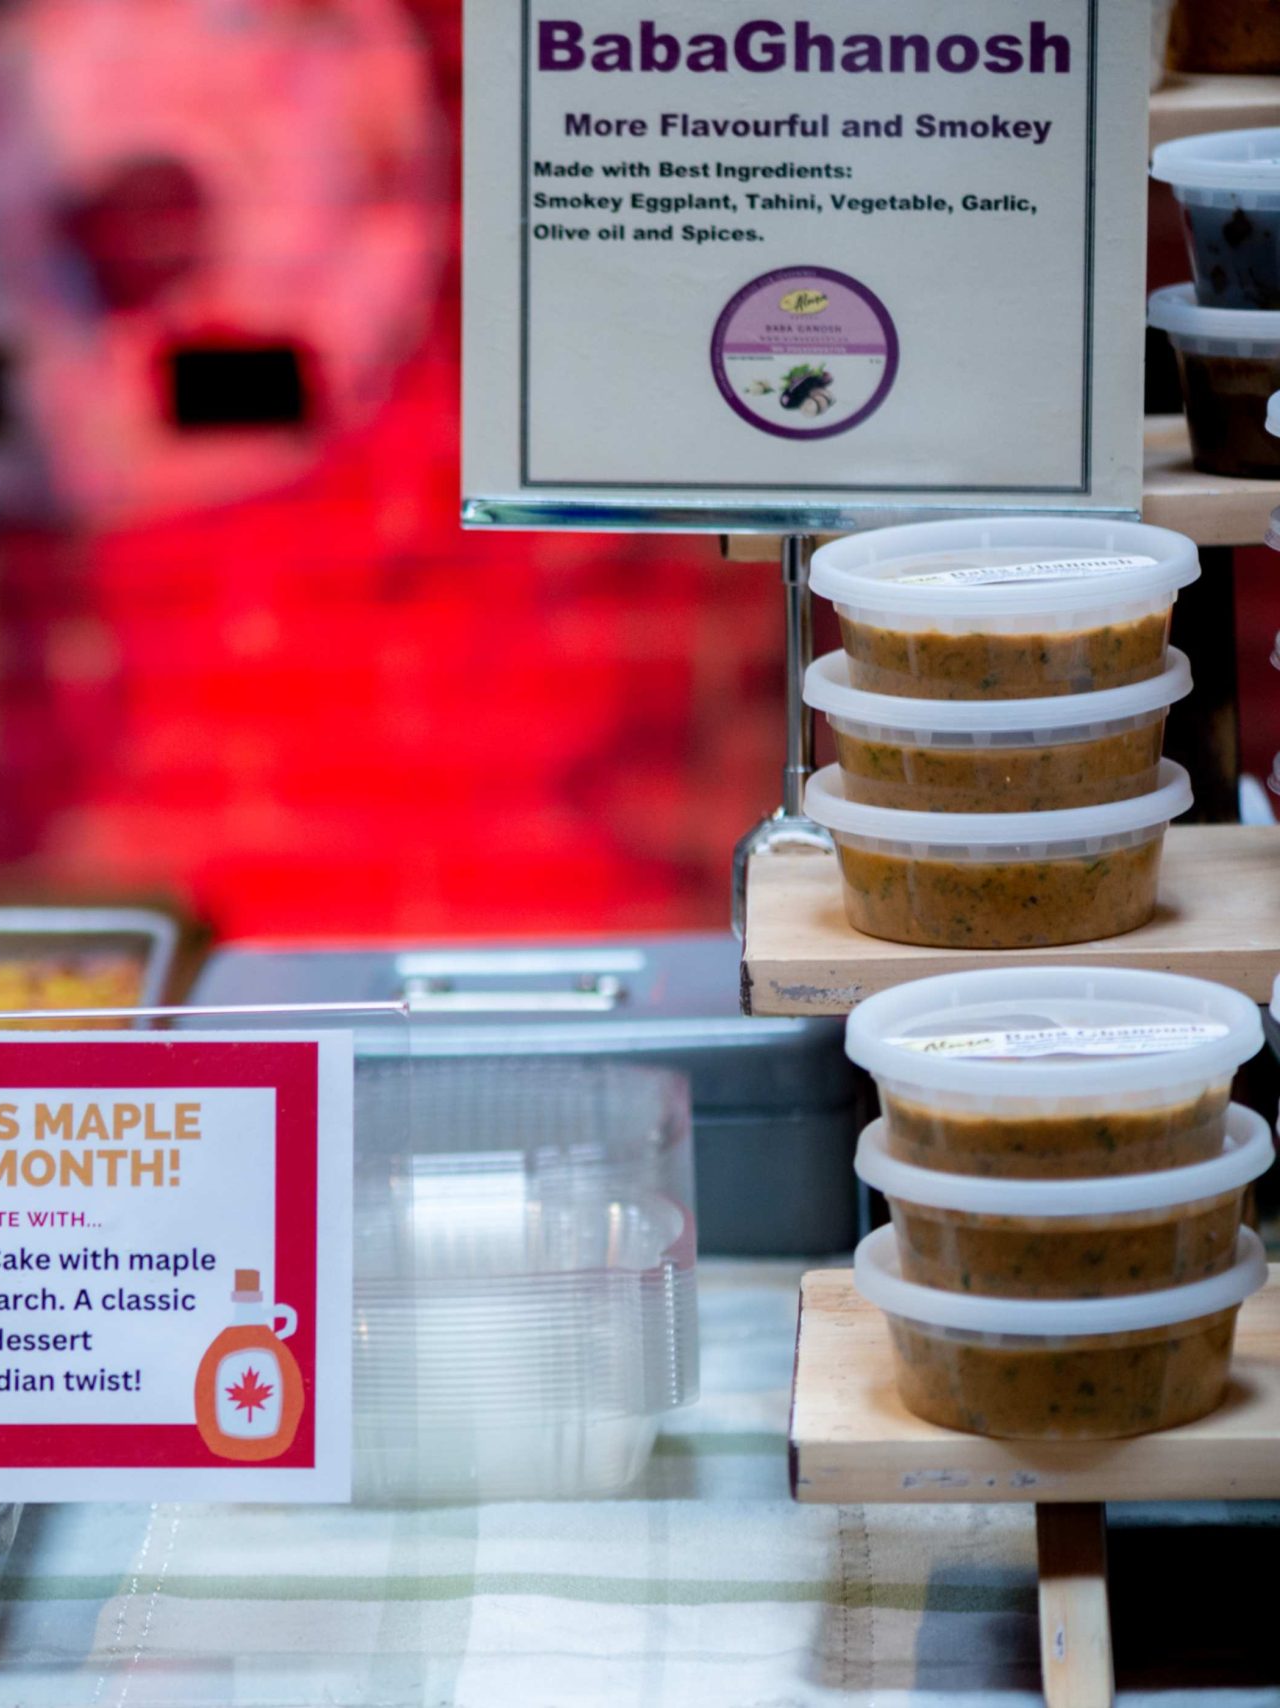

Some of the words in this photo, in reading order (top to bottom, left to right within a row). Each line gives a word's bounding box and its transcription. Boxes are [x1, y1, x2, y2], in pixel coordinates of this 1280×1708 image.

[538, 19, 1071, 75] BabaGhanosh
[565, 113, 647, 137] More
[660, 113, 829, 138] Flavourful
[841, 114, 903, 138] and
[915, 113, 1053, 145] Smokey
[533, 161, 594, 178] Made
[601, 161, 651, 178] with
[658, 161, 710, 178] Best
[716, 161, 852, 183] Ingredients:
[533, 192, 623, 213] Smokey
[630, 192, 738, 214] Eggplant,
[745, 193, 823, 213] Tahini,
[830, 194, 954, 215] Vegetable,
[961, 194, 1038, 215] Garlic,
[533, 224, 591, 241] Olive
[597, 224, 625, 241] oil
[632, 224, 674, 241] and
[681, 224, 764, 245] Spices.
[34, 1102, 202, 1141] MAPLE
[26, 1211, 102, 1228] WITH...
[58, 1247, 119, 1271] with
[128, 1247, 217, 1277] maple
[73, 1288, 93, 1311] A
[101, 1287, 196, 1312] classic
[63, 1368, 142, 1392] twist!
